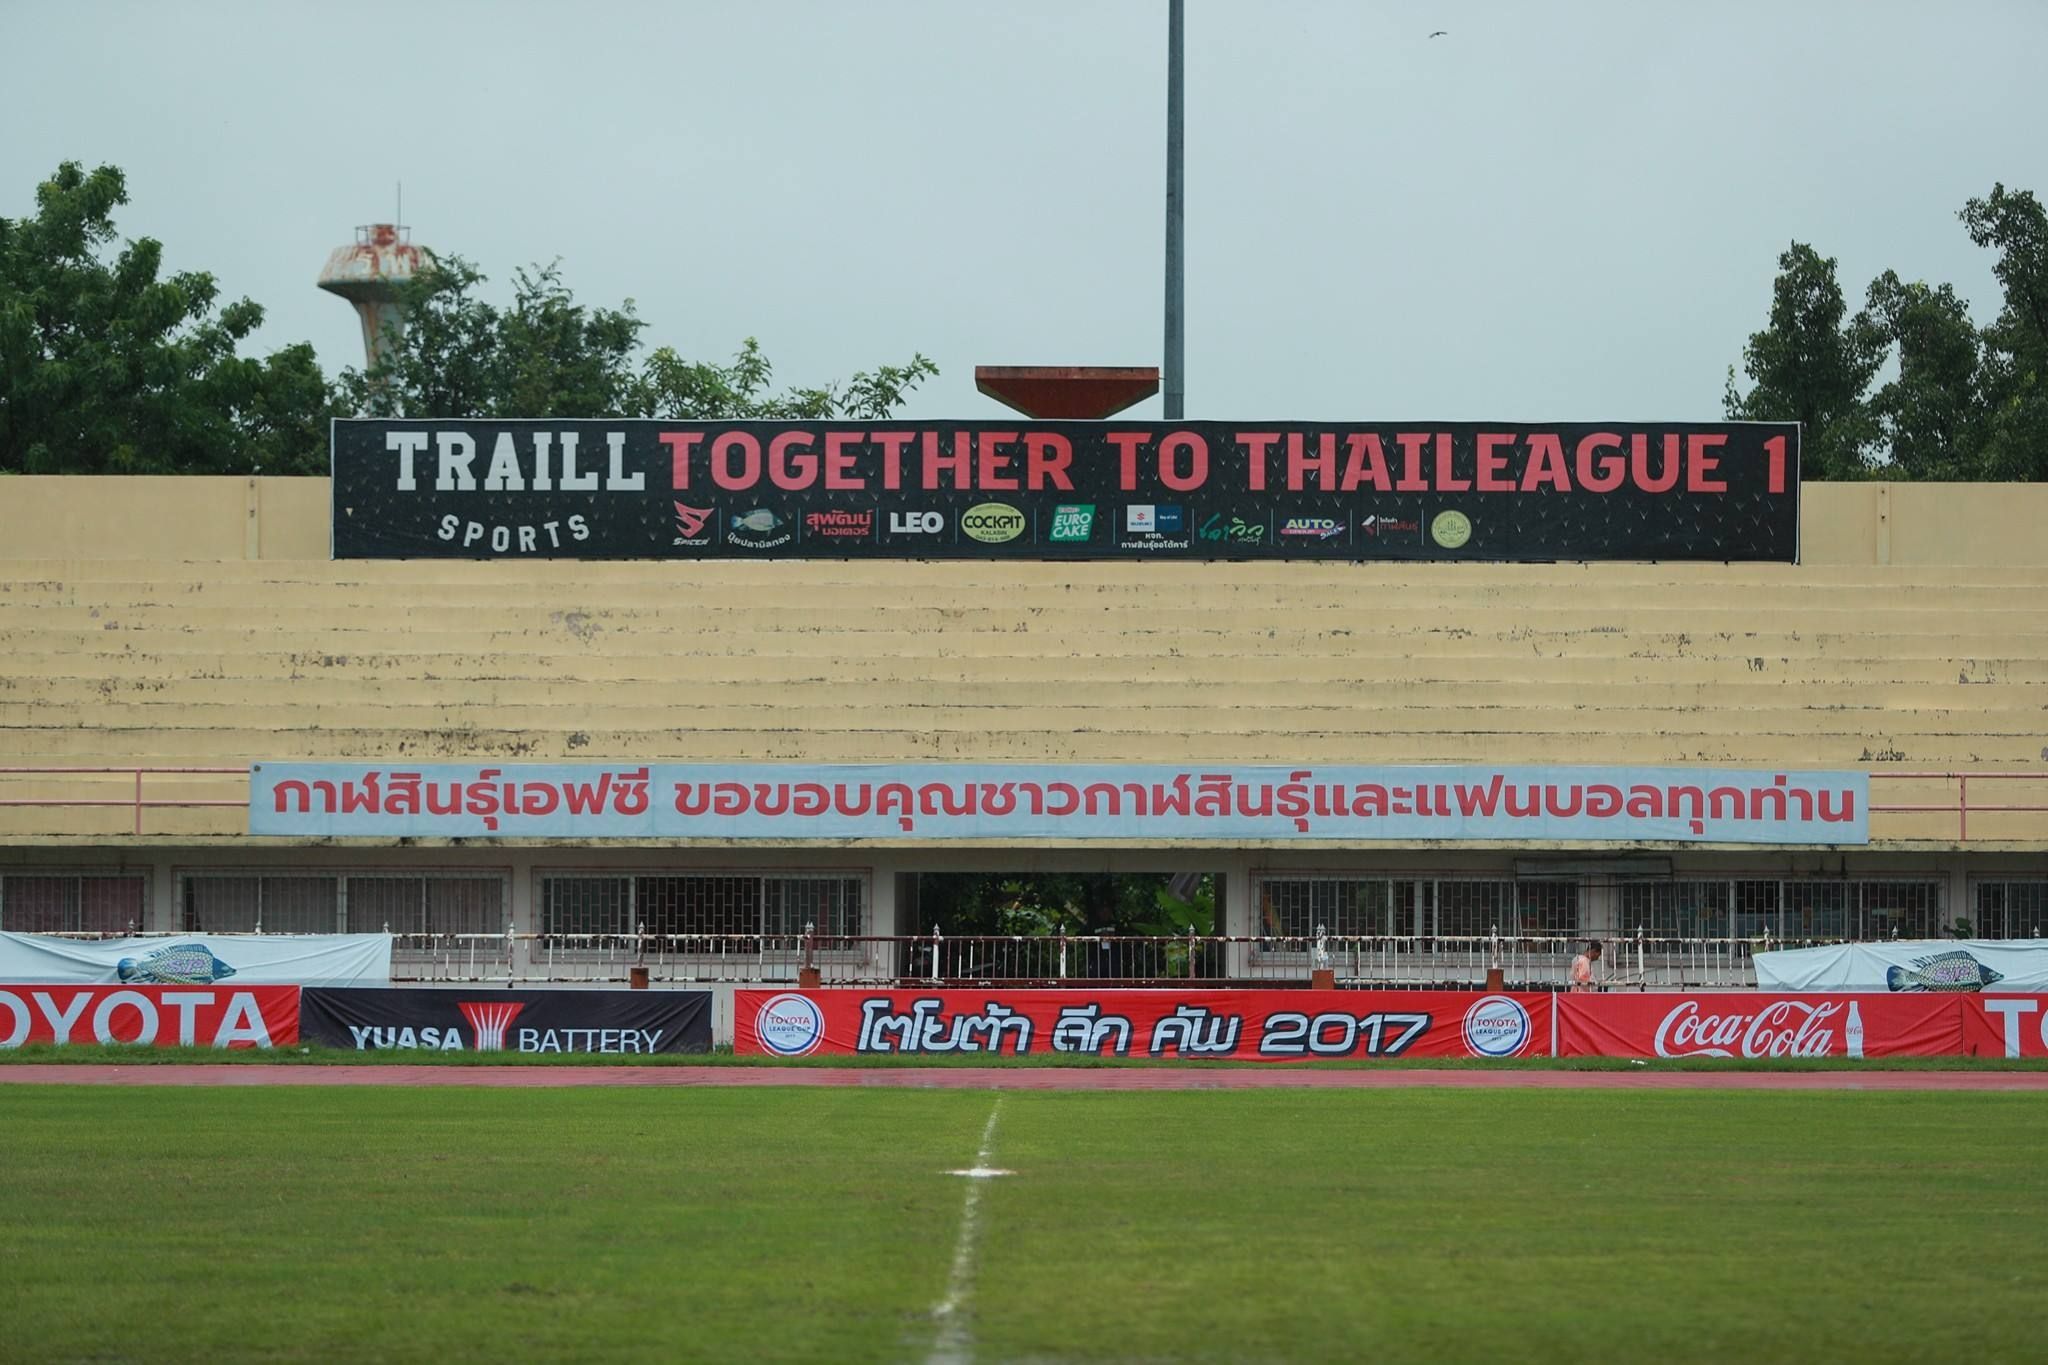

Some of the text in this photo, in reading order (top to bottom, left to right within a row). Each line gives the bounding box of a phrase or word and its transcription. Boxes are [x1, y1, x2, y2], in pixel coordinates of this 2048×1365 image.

[386, 431, 1786, 494] TRAILL TOGETHER TO THAILEAGUE 1
[890, 511, 944, 534] LEO
[963, 515, 1022, 529] COCKPIT
[1054, 512, 1092, 526] EURO
[1286, 519, 1335, 529] AUTO
[437, 513, 590, 552] SPORTS
[1052, 524, 1089, 538] CAKE
[273, 767, 1855, 834] กาฬสินธุ์เอฟซี ขอขอบคุณชาวกาฬสินธุ์และแฟนบอลทุกท่าน
[769, 1016, 810, 1025] TOYOTA
[796, 1025, 811, 1033] CUP
[857, 999, 1429, 1054] โตโยต้า ลีก คัพ 2017
[1477, 1019, 1517, 1027] TOYOTA
[1653, 1000, 1845, 1057] Coca-Cola
[350, 1026, 663, 1054] YUASA BATTERY
